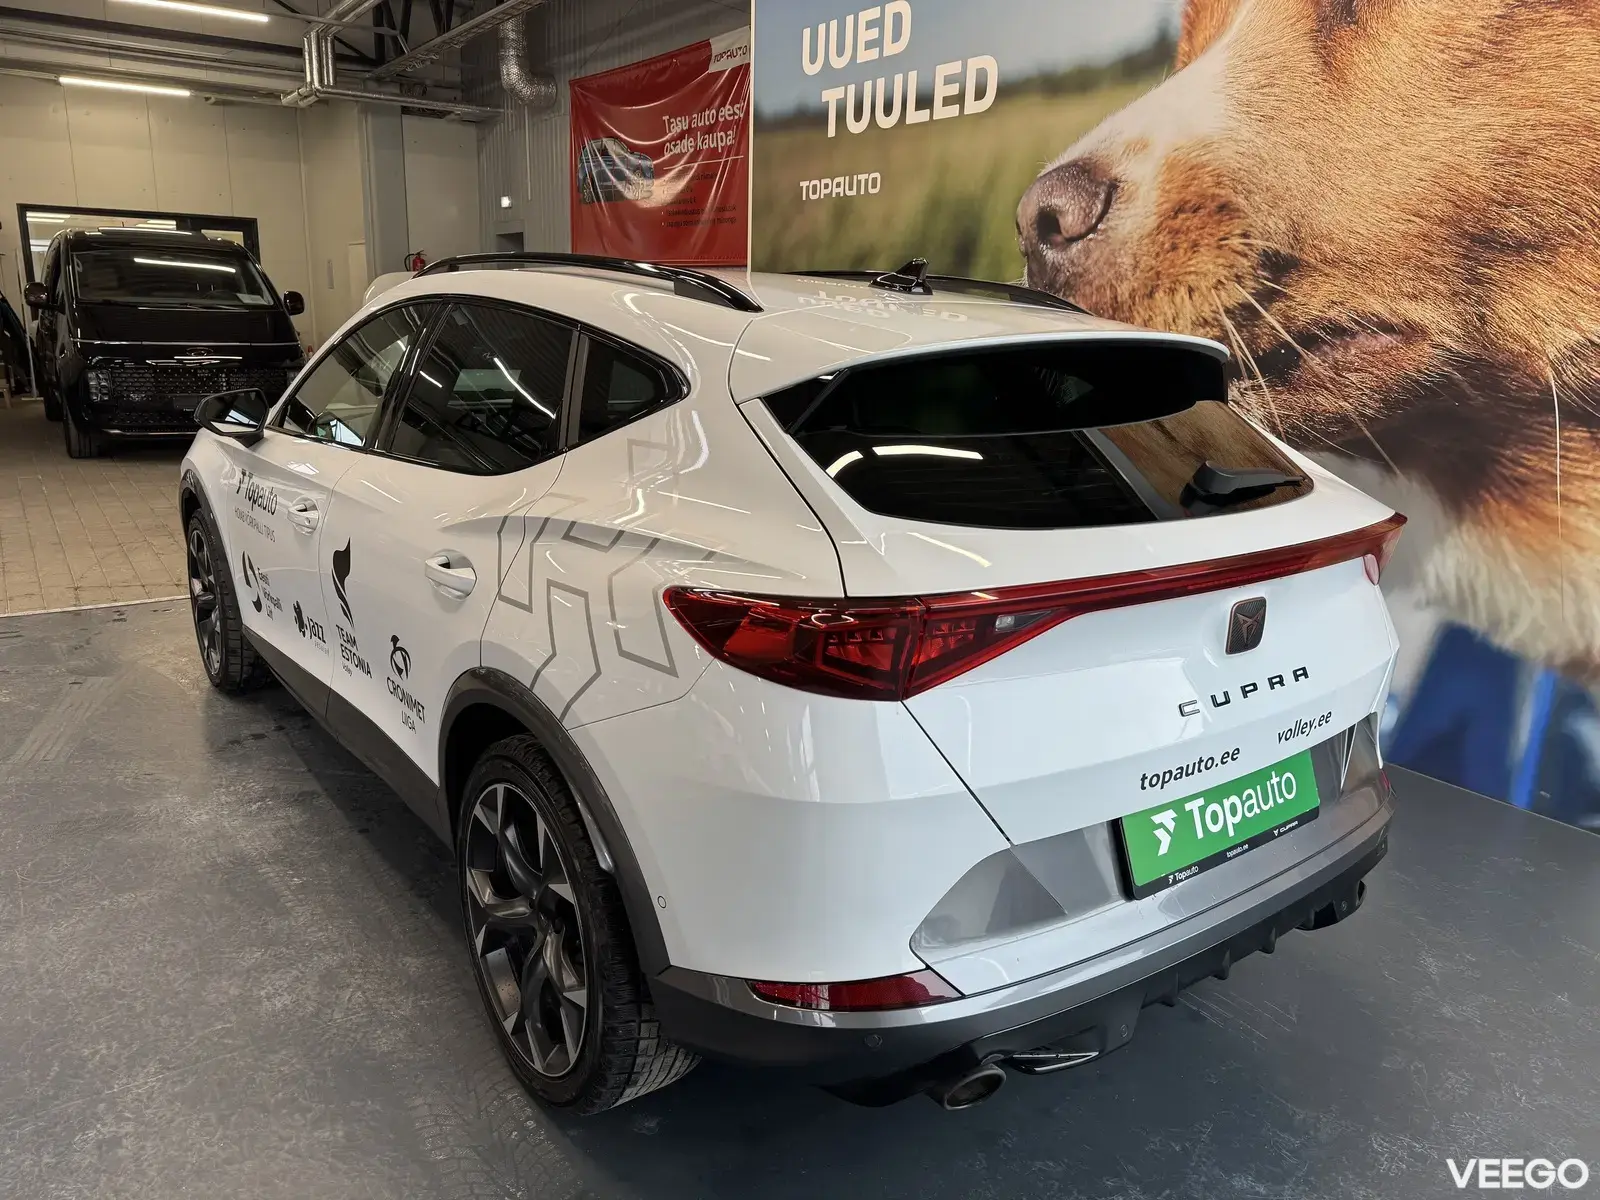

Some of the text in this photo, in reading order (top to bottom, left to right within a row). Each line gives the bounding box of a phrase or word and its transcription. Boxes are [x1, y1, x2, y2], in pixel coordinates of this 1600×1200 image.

[713, 44, 748, 63] TOPAUTO
[802, 0, 912, 76] UUED
[821, 55, 999, 138] TUULED
[662, 114, 689, 133] Tasu
[691, 108, 716, 127] auto
[664, 125, 736, 156] osade kaupa!
[800, 172, 881, 201] TOPAUTO
[245, 472, 278, 516] Topauto
[335, 624, 359, 652] TEAM
[340, 642, 373, 679] ESTONIA
[386, 676, 426, 724] CRONIMET
[1178, 666, 1310, 718] CUPRA
[1277, 710, 1333, 745] volley.ee
[1139, 747, 1241, 791] topauto.ee
[1184, 771, 1297, 839] Topauto
[1226, 843, 1249, 858] topauto.ee
[1174, 865, 1199, 881] Topauto
